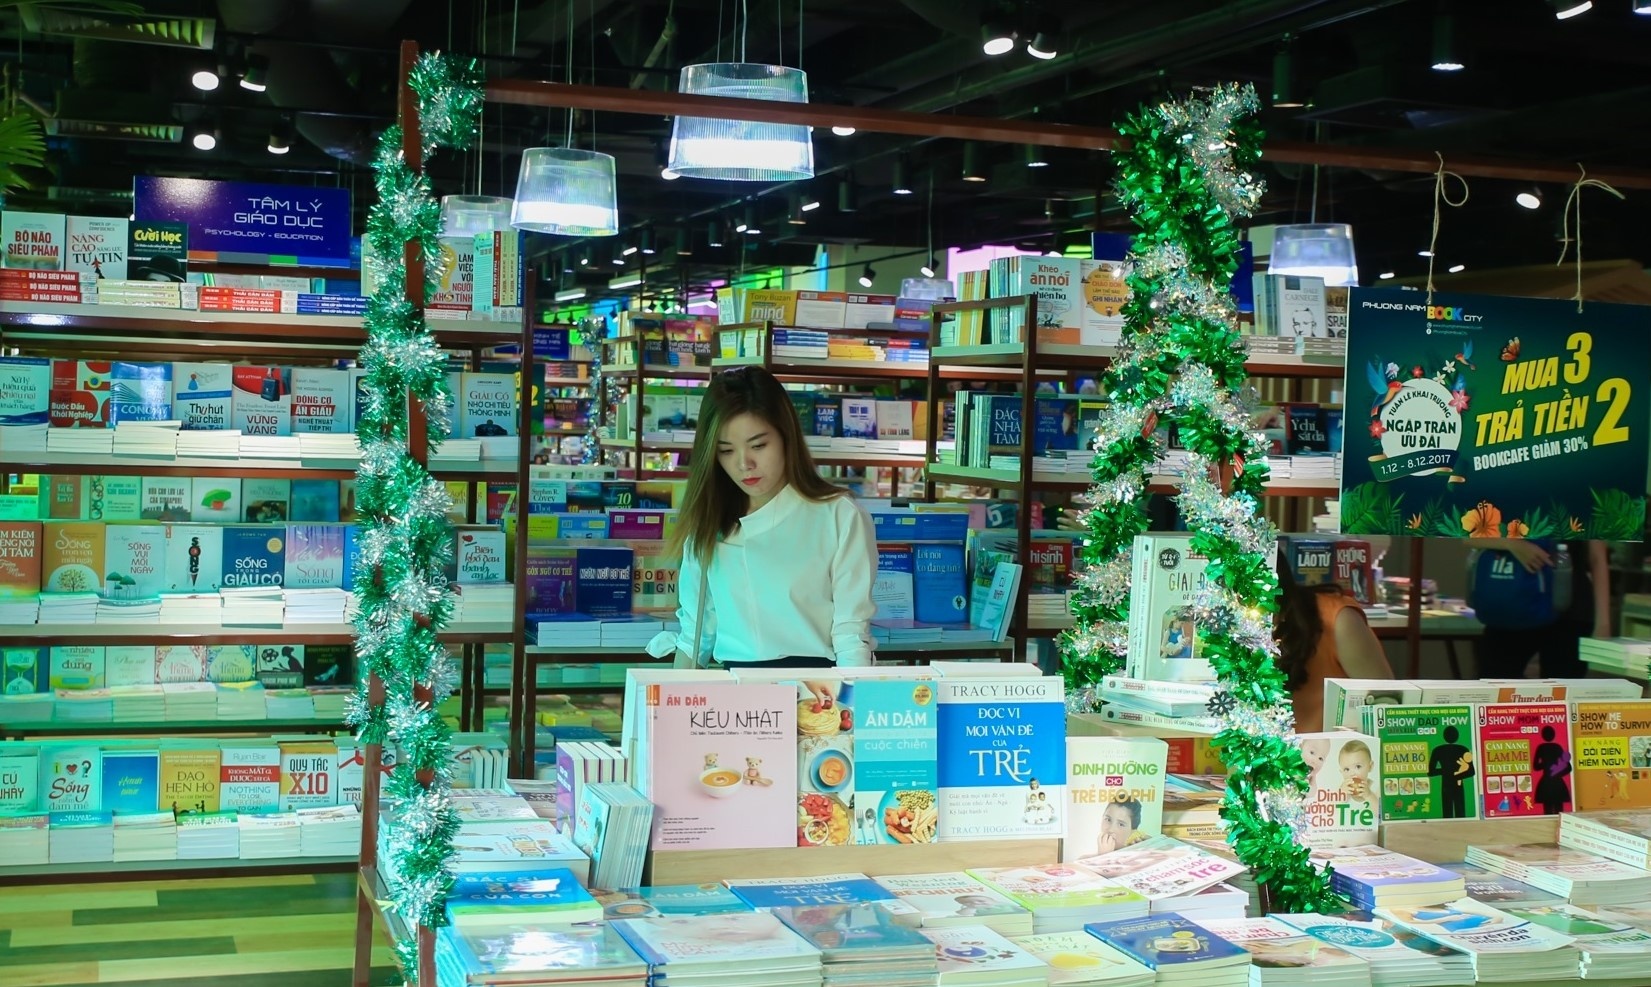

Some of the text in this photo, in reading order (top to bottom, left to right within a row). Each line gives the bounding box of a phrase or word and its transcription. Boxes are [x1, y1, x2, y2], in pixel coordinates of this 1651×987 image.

[248, 196, 323, 213] TÂM LÝ
[234, 210, 324, 229] GIÁO DỤC
[161, 231, 182, 245] Học
[204, 228, 266, 238] PSYCHOLOGY
[274, 232, 324, 241] EDUCATION
[72, 252, 124, 266] TỰ TIN
[1038, 264, 1059, 273] Khéo
[1030, 273, 1047, 285] ăn
[750, 292, 769, 301] Tony
[751, 305, 785, 320] mind
[1405, 303, 1427, 312] NAM
[1426, 305, 1463, 321] BOOK
[1463, 314, 1483, 322] CITY
[1502, 331, 1593, 395] MUA 3
[494, 391, 510, 401] CÓ
[1412, 391, 1429, 399] KHAI
[51, 402, 85, 411] Bước Đầu
[484, 401, 496, 409] CHI
[68, 411, 94, 421] Nghiệp
[1475, 377, 1632, 448] TRẢ TIỀN 2
[1386, 418, 1422, 435] NGẬP
[1401, 434, 1417, 448] ƯU
[1473, 435, 1589, 471] BOOKCAFE GIẢM 30%
[1381, 463, 1398, 475] 1.12
[1407, 454, 1451, 469] 8.12.2017
[531, 488, 552, 496] Stephen
[533, 494, 556, 502] Covey
[617, 492, 632, 505] 10
[134, 550, 149, 558] VUI
[1298, 551, 1332, 567] LÃO TỬ
[1336, 547, 1367, 563] KHỔNG
[235, 556, 268, 569] SỐNG
[634, 570, 676, 581] BODY
[1337, 563, 1350, 578] TỬ
[224, 571, 283, 586] GIÀU CÓ
[1169, 572, 1193, 592] GIAI
[634, 583, 676, 593] SIGN
[951, 685, 1047, 697] TRACY HOGG
[666, 694, 707, 709] ĂN DẶM
[735, 708, 783, 729] NHẬT
[865, 709, 927, 729] ĂN DẶM
[978, 707, 1021, 721] ĐỌC VỊ
[1488, 714, 1565, 725] SHOW MOM HOW
[1580, 712, 1622, 721] SHOW ME
[1387, 716, 1468, 727] SHOW DAD HOW
[1580, 722, 1603, 730] HOW
[1605, 721, 1618, 730] TO
[966, 721, 1034, 738] MỌI VẤN ĐỀ
[864, 738, 928, 751] cuộc chiến
[992, 738, 1007, 747] CỦA
[233, 753, 251, 761] Ryan
[969, 744, 1032, 783] TRẺ
[1602, 758, 1626, 766] NGUY
[290, 757, 329, 772] QUY TẮC
[1072, 760, 1158, 776] DINH DƯỠNG
[2, 772, 18, 785] CÚ
[289, 772, 329, 795] X10
[1106, 777, 1122, 785] CHO
[49, 777, 90, 803] Sống
[166, 783, 192, 794] HẸN
[228, 786, 271, 794] NOTHING
[1071, 784, 1156, 804] TRẺ BÉO PHÌ
[1317, 788, 1347, 802] Dinh
[1312, 801, 1374, 827] Cho Trẻ
[951, 826, 980, 834] TRACY
[983, 825, 1008, 833] HOGG
[519, 892, 561, 900] CON
